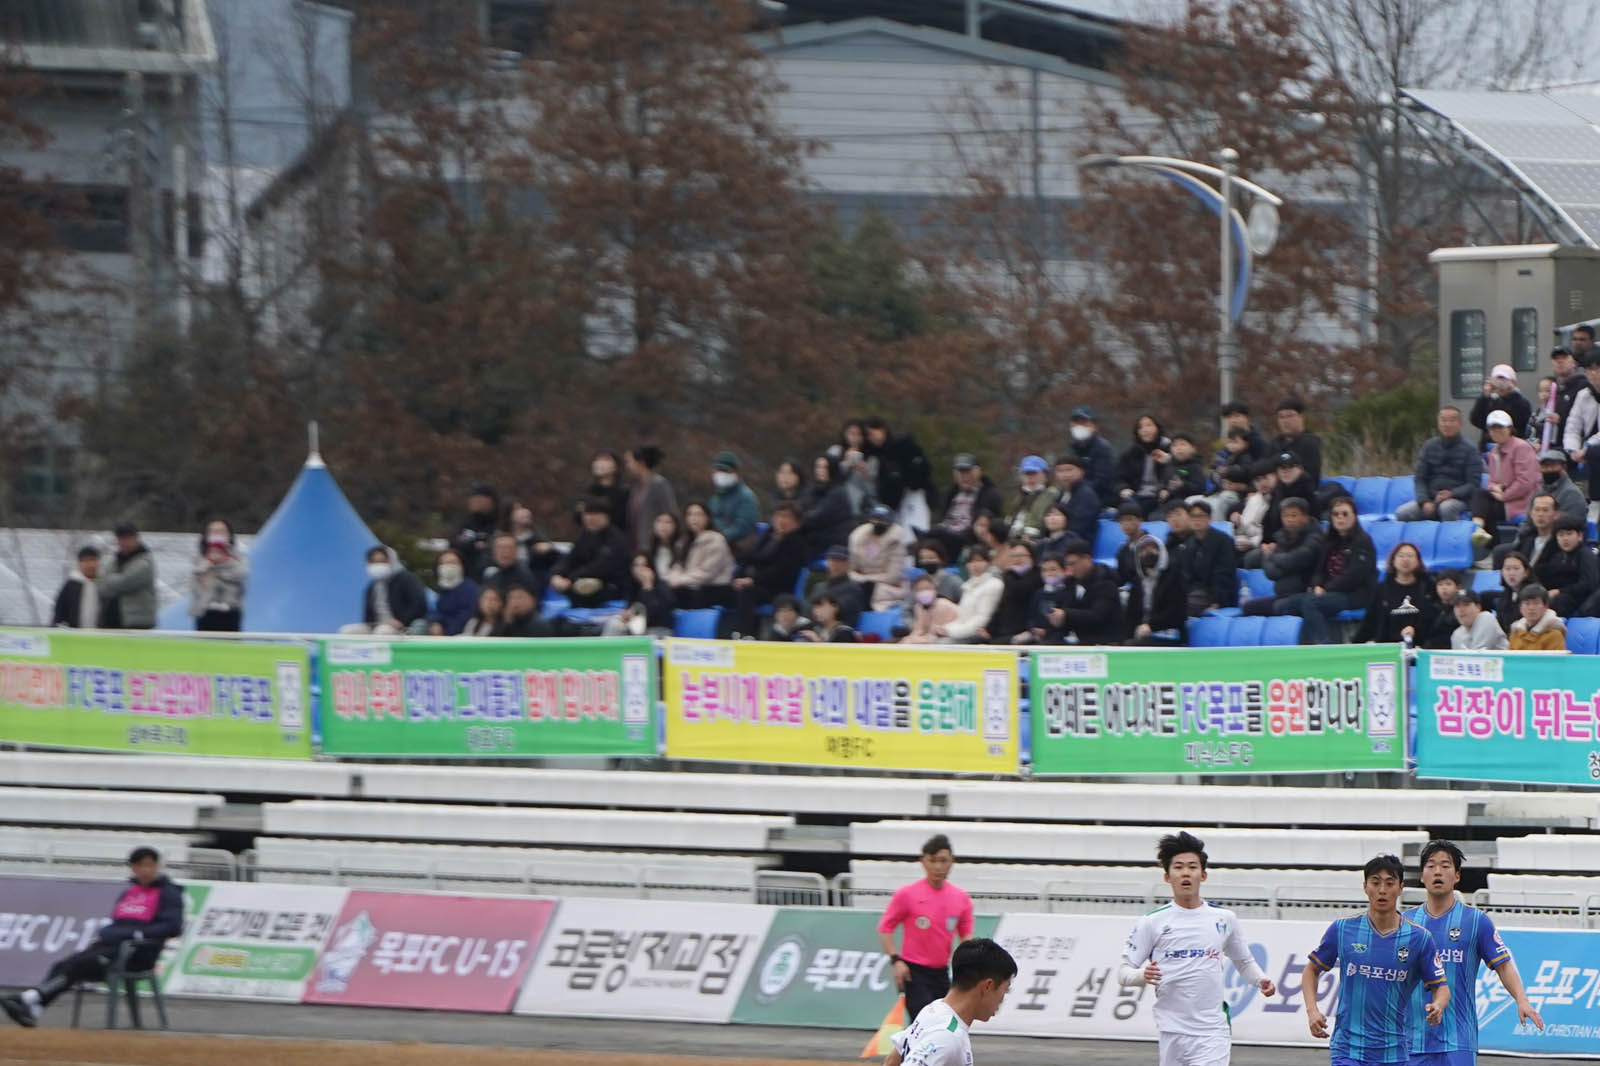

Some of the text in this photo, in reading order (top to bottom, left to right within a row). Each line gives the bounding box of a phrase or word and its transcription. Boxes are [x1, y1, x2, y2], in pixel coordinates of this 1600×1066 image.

[1180, 681, 1263, 735] FC목포를
[1269, 680, 1362, 734] 응원합니다
[1435, 687, 1524, 737] 심장이
[454, 937, 528, 977] U-15
[805, 948, 896, 992] 목포FC
[1545, 1024, 1591, 1039] CHRISTIAN
